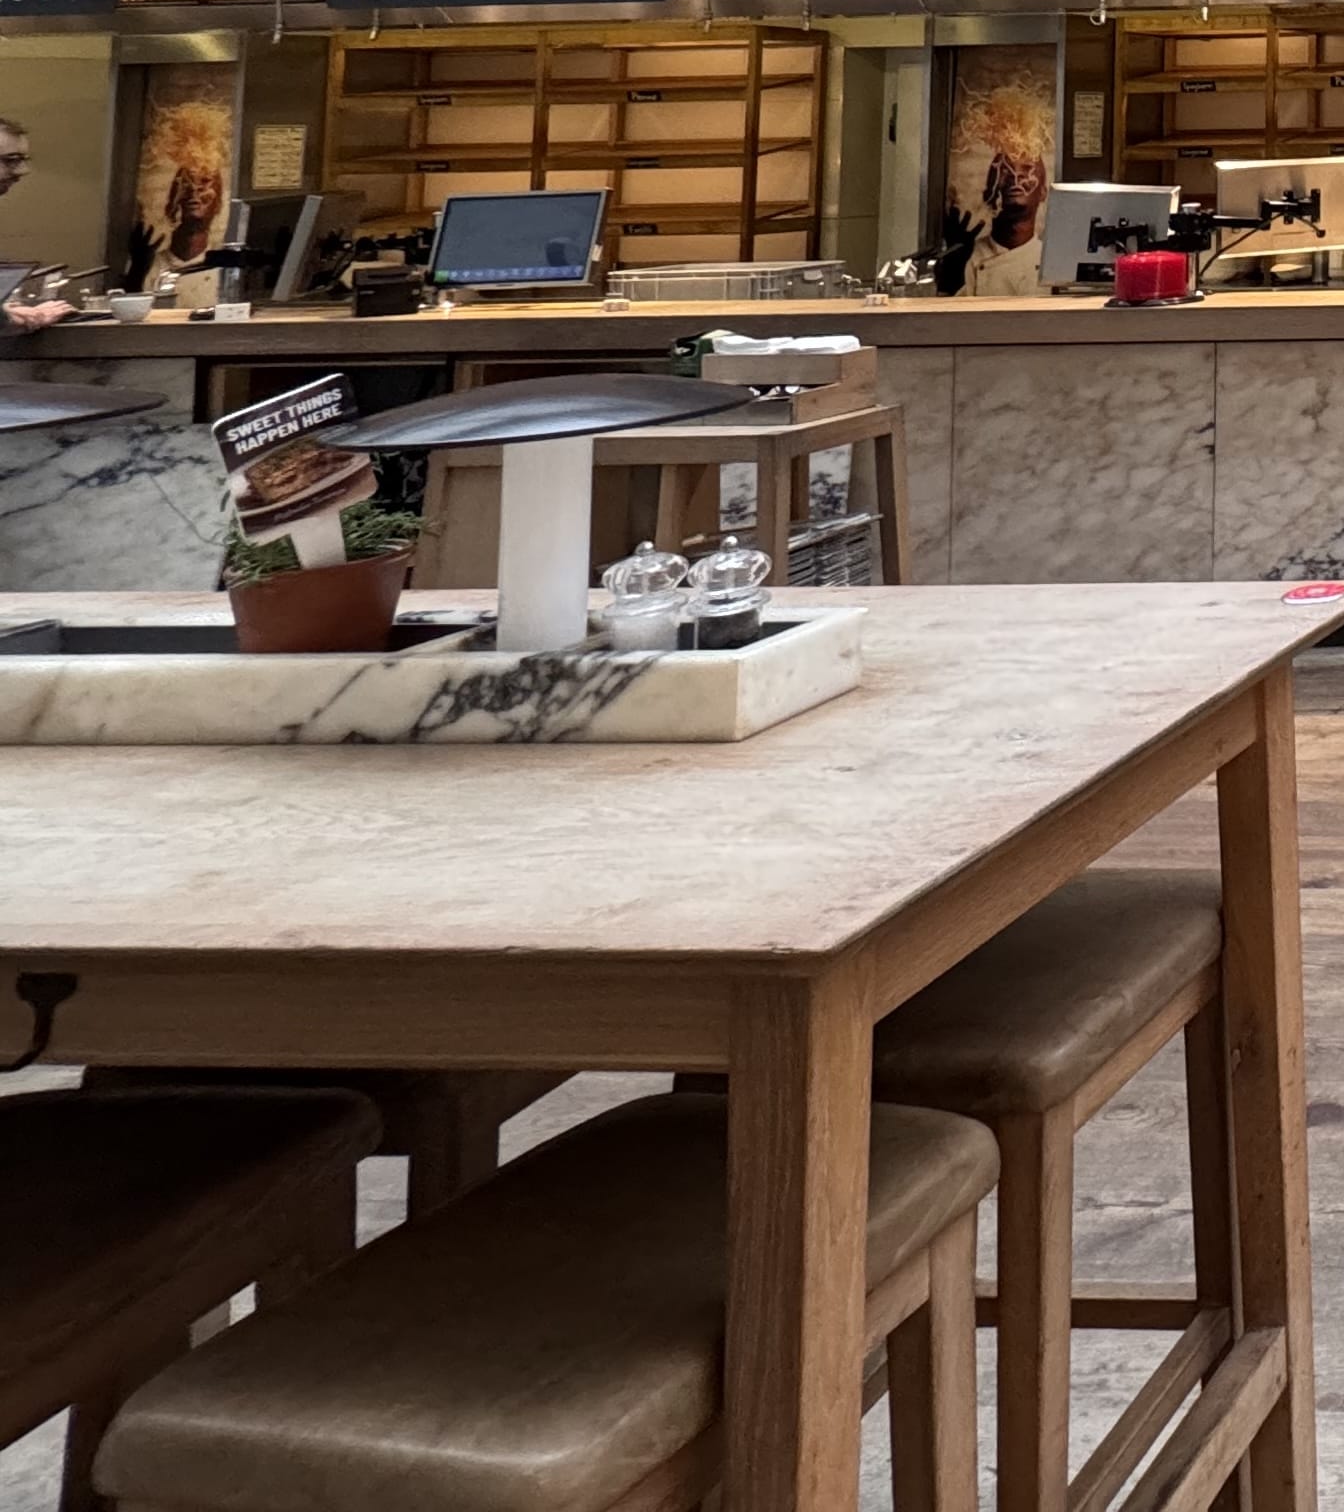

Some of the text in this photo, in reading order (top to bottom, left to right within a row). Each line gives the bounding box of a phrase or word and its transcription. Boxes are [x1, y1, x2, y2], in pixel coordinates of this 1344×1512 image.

[226, 388, 343, 442] SWEET THINGS
[234, 403, 342, 455] HAPPEN HERE
